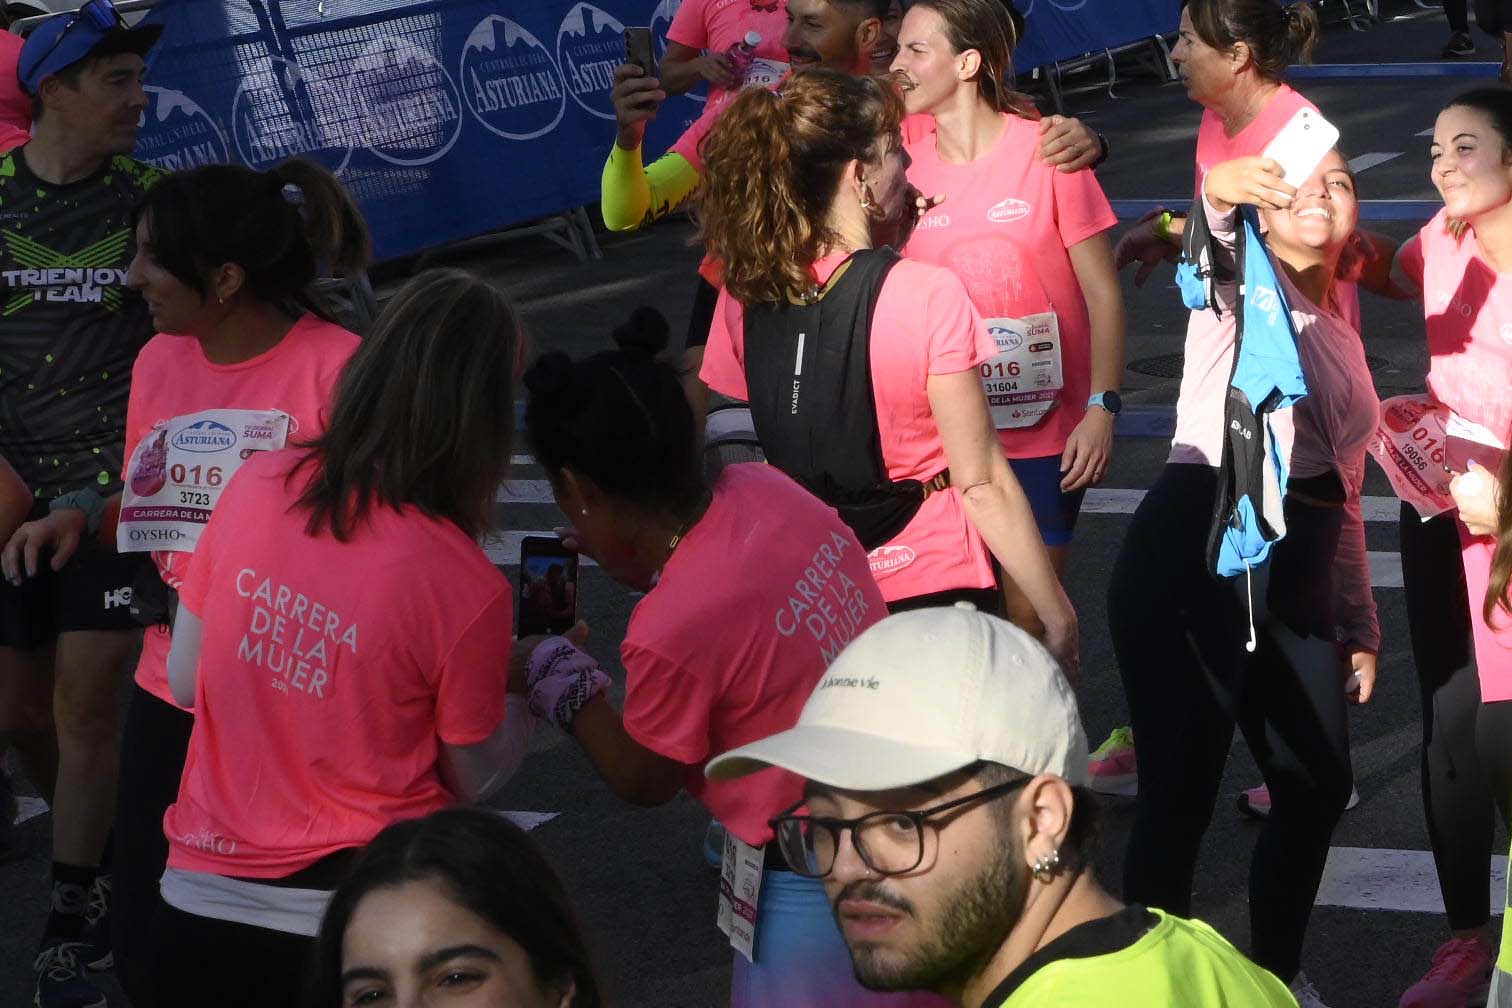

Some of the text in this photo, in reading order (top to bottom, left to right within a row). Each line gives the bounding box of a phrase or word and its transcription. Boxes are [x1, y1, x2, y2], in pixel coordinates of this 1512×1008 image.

[470, 64, 564, 113] ASTURIANA
[2, 267, 129, 288] TRIENJOY
[28, 284, 103, 302] TEAM
[980, 361, 1021, 378] 016
[791, 379, 801, 415] EVADICT
[986, 381, 1018, 393] 31604
[1012, 394, 1037, 402] MUJER
[175, 433, 230, 446] ASTURIANA
[243, 430, 273, 440] SUMA
[1412, 427, 1444, 464] 016
[1403, 443, 1428, 471] 19056
[170, 464, 222, 487] 016
[180, 491, 210, 505] 3723
[133, 510, 179, 518] CARRERA
[180, 511, 193, 519] DE
[775, 530, 850, 636] CARRERA
[236, 568, 359, 654] CARRERA
[805, 570, 856, 641] DE LA
[250, 605, 330, 667] DE LA
[820, 589, 870, 668] MUJER
[237, 633, 329, 700] MUJER
